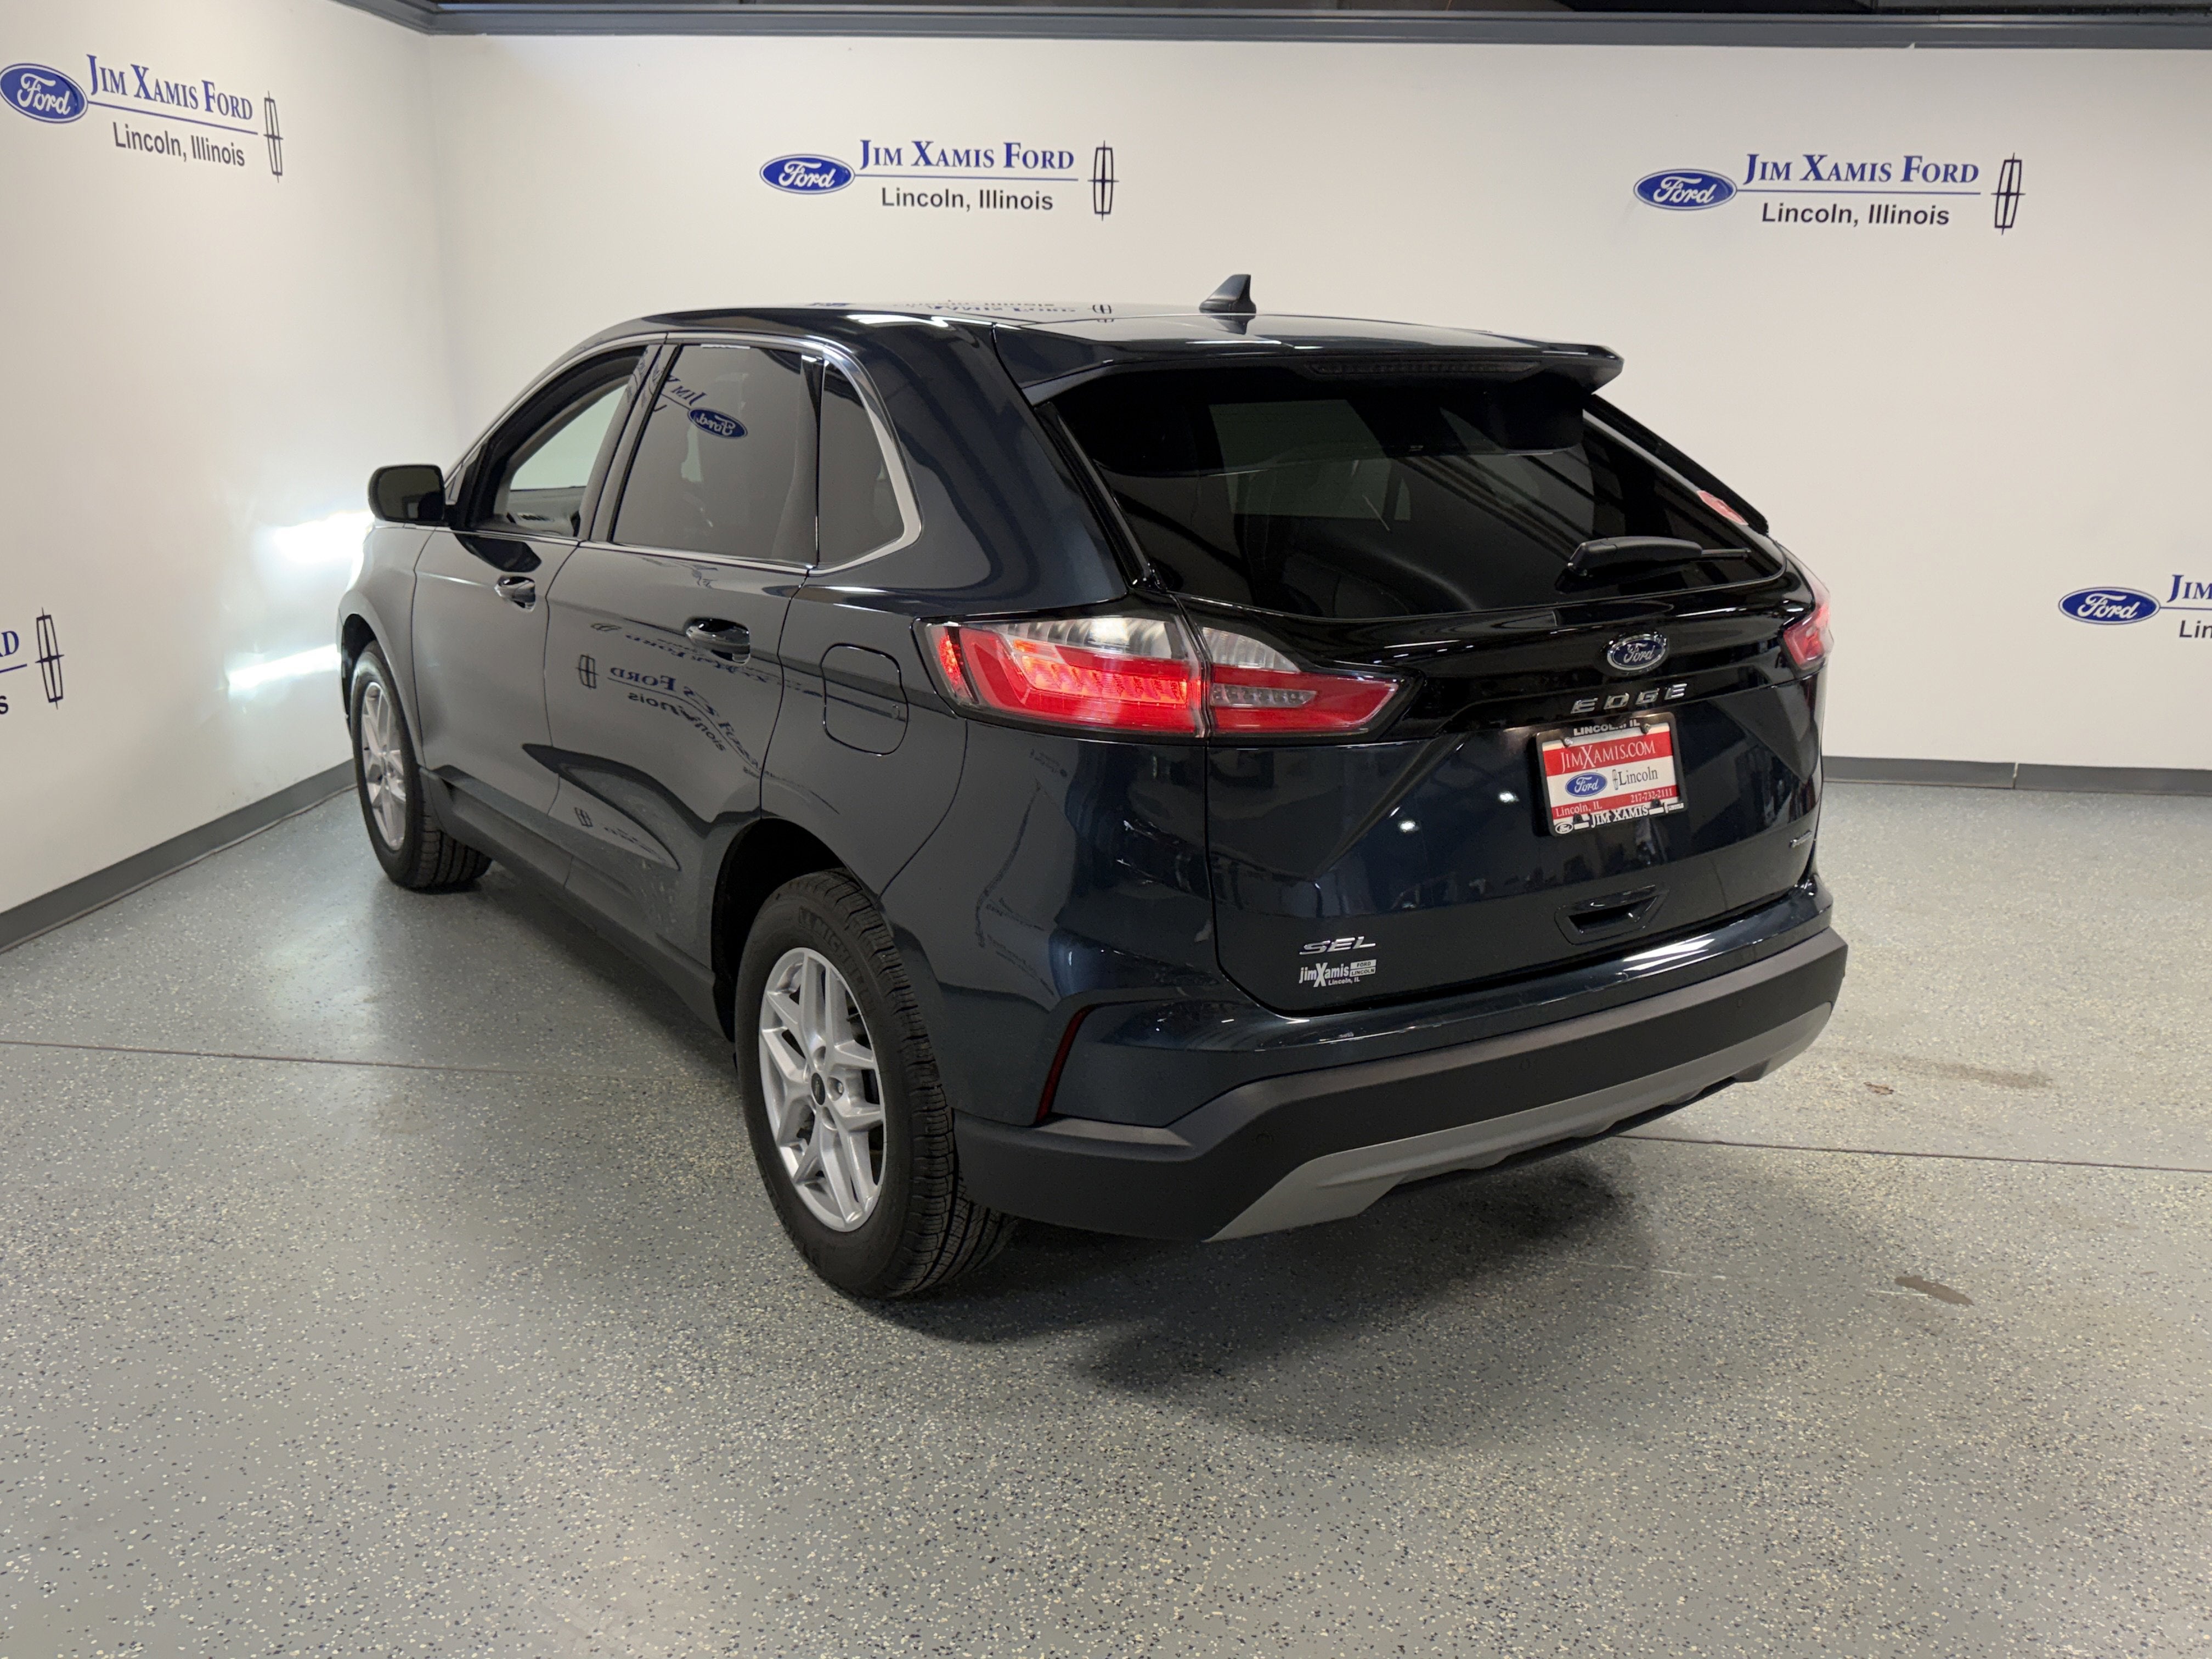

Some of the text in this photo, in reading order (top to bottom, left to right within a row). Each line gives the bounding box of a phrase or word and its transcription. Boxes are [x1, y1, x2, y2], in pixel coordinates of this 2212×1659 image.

[17, 73, 71, 115] Ford
[86, 54, 253, 120] JIM XAMIS FORD
[112, 122, 245, 167] Lincoln, Illinois
[860, 139, 1074, 170] JIM XAMIS FORD
[778, 160, 836, 188] Ford
[1743, 154, 1979, 185] JIM XAMIS FORD
[882, 187, 1053, 212] Lincoln, Illinois
[1652, 175, 1717, 205] Ford
[1762, 202, 1949, 227] Lincoln, Illinois
[2077, 592, 2141, 619] Ford
[1623, 642, 1657, 663] Ford
[1570, 683, 1688, 714] EDGE
[1629, 719, 1640, 727] IL
[1574, 776, 1599, 793] Ford
[1618, 766, 1658, 786] Lincoln
[1630, 788, 1673, 803] 217-732-2111
[1555, 800, 1602, 817] Lincoln, IL
[1591, 813, 1612, 828] JIM
[1612, 805, 1649, 822] XAMIS
[1299, 936, 1376, 955] SEL
[1328, 977, 1353, 986] Lincoln,
